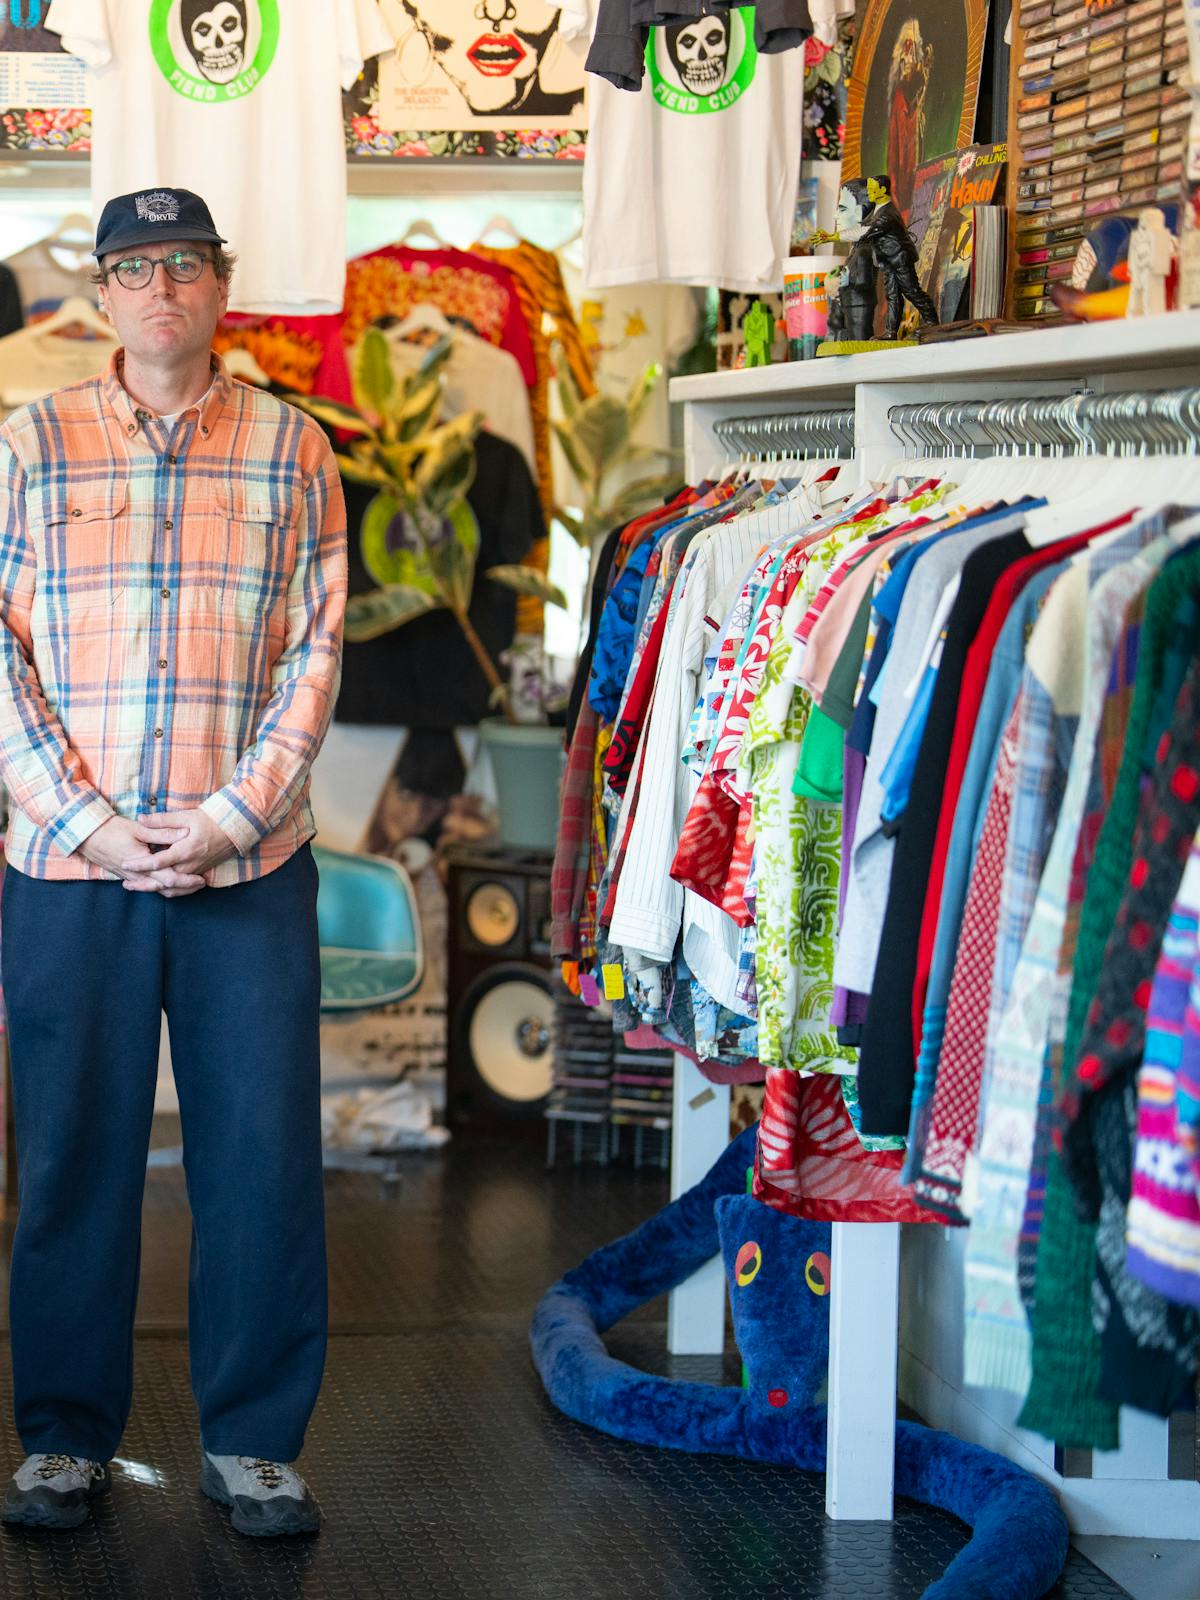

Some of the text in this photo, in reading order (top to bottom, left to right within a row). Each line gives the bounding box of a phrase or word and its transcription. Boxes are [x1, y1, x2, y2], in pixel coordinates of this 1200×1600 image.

[170, 69, 217, 101] FIEND
[654, 80, 741, 112] FIEND CLUB
